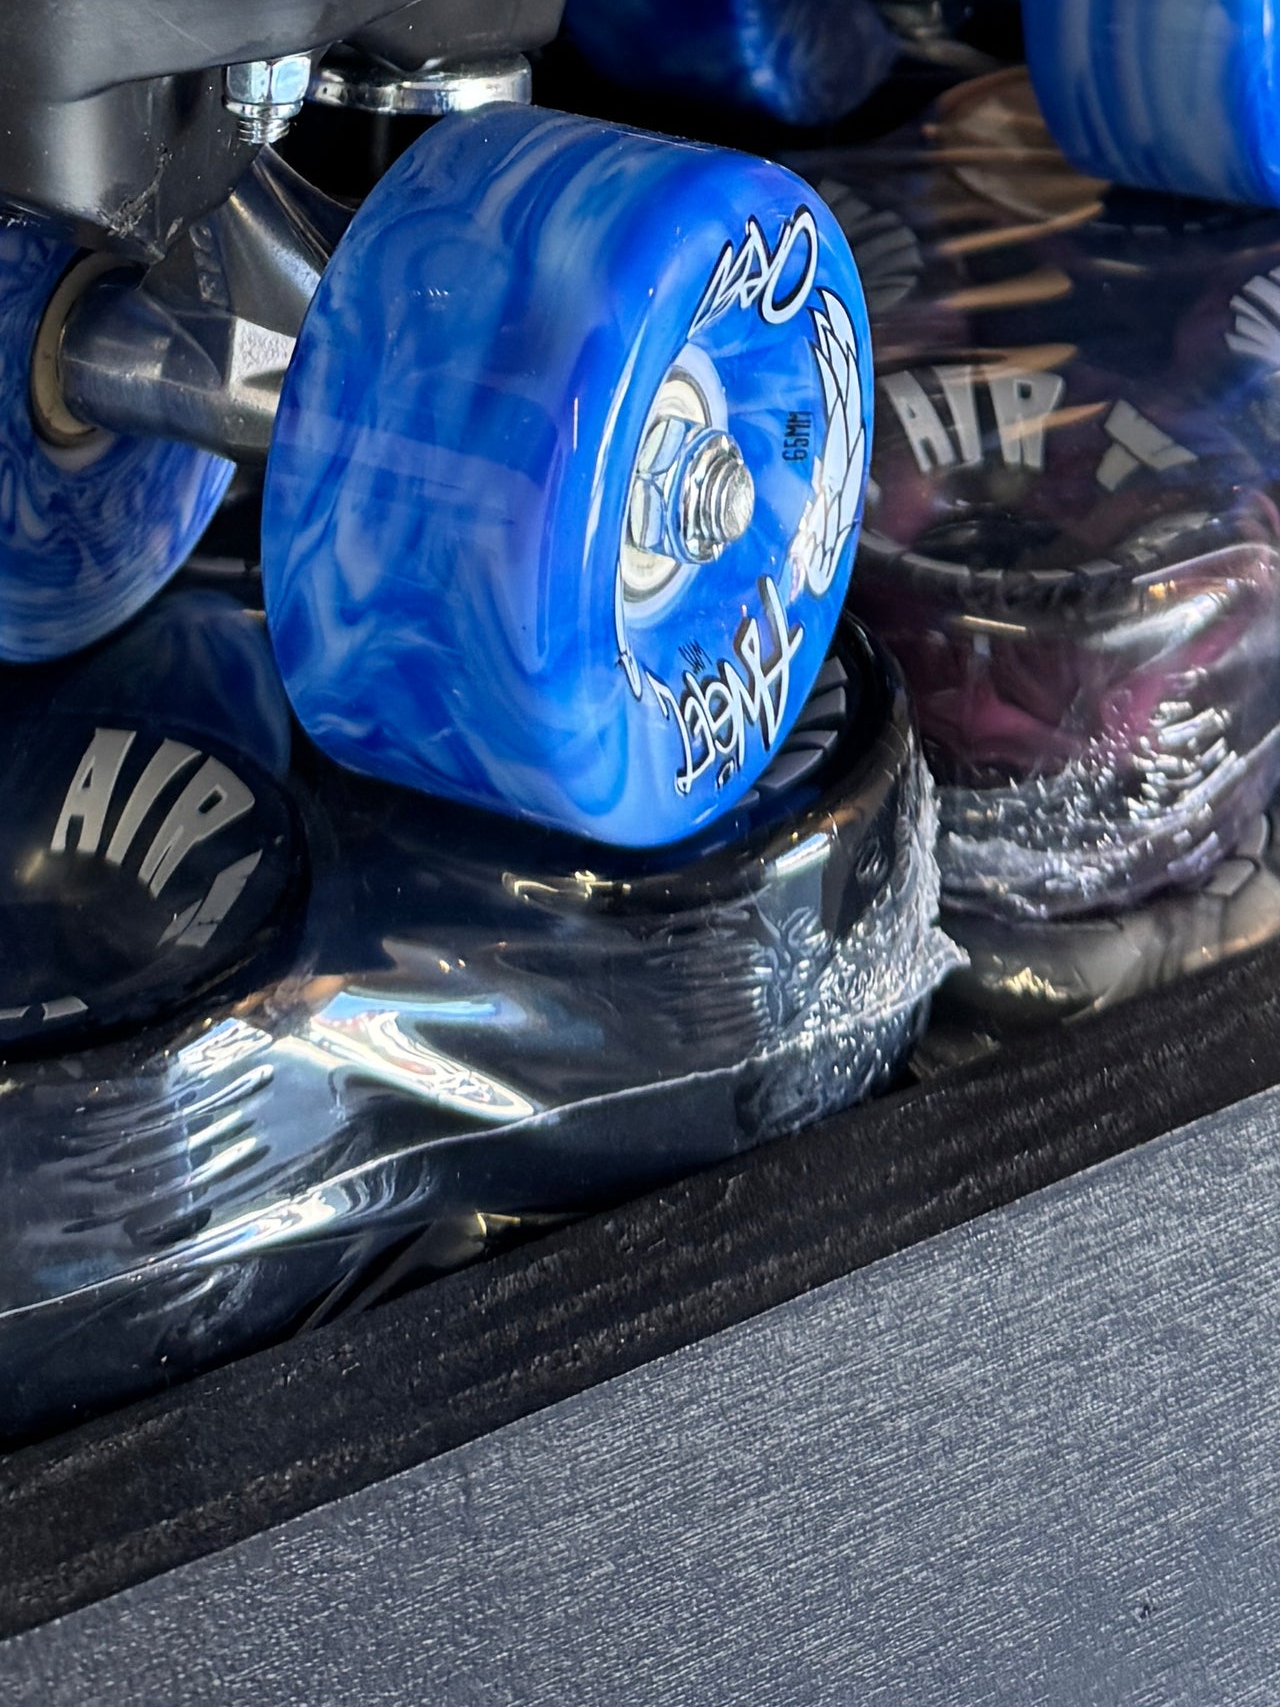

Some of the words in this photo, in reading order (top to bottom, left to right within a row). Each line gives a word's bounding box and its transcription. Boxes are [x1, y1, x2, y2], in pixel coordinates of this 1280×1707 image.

[781, 410, 814, 463] 65MM
[876, 363, 1066, 475] AIR
[51, 727, 257, 899] AIR
